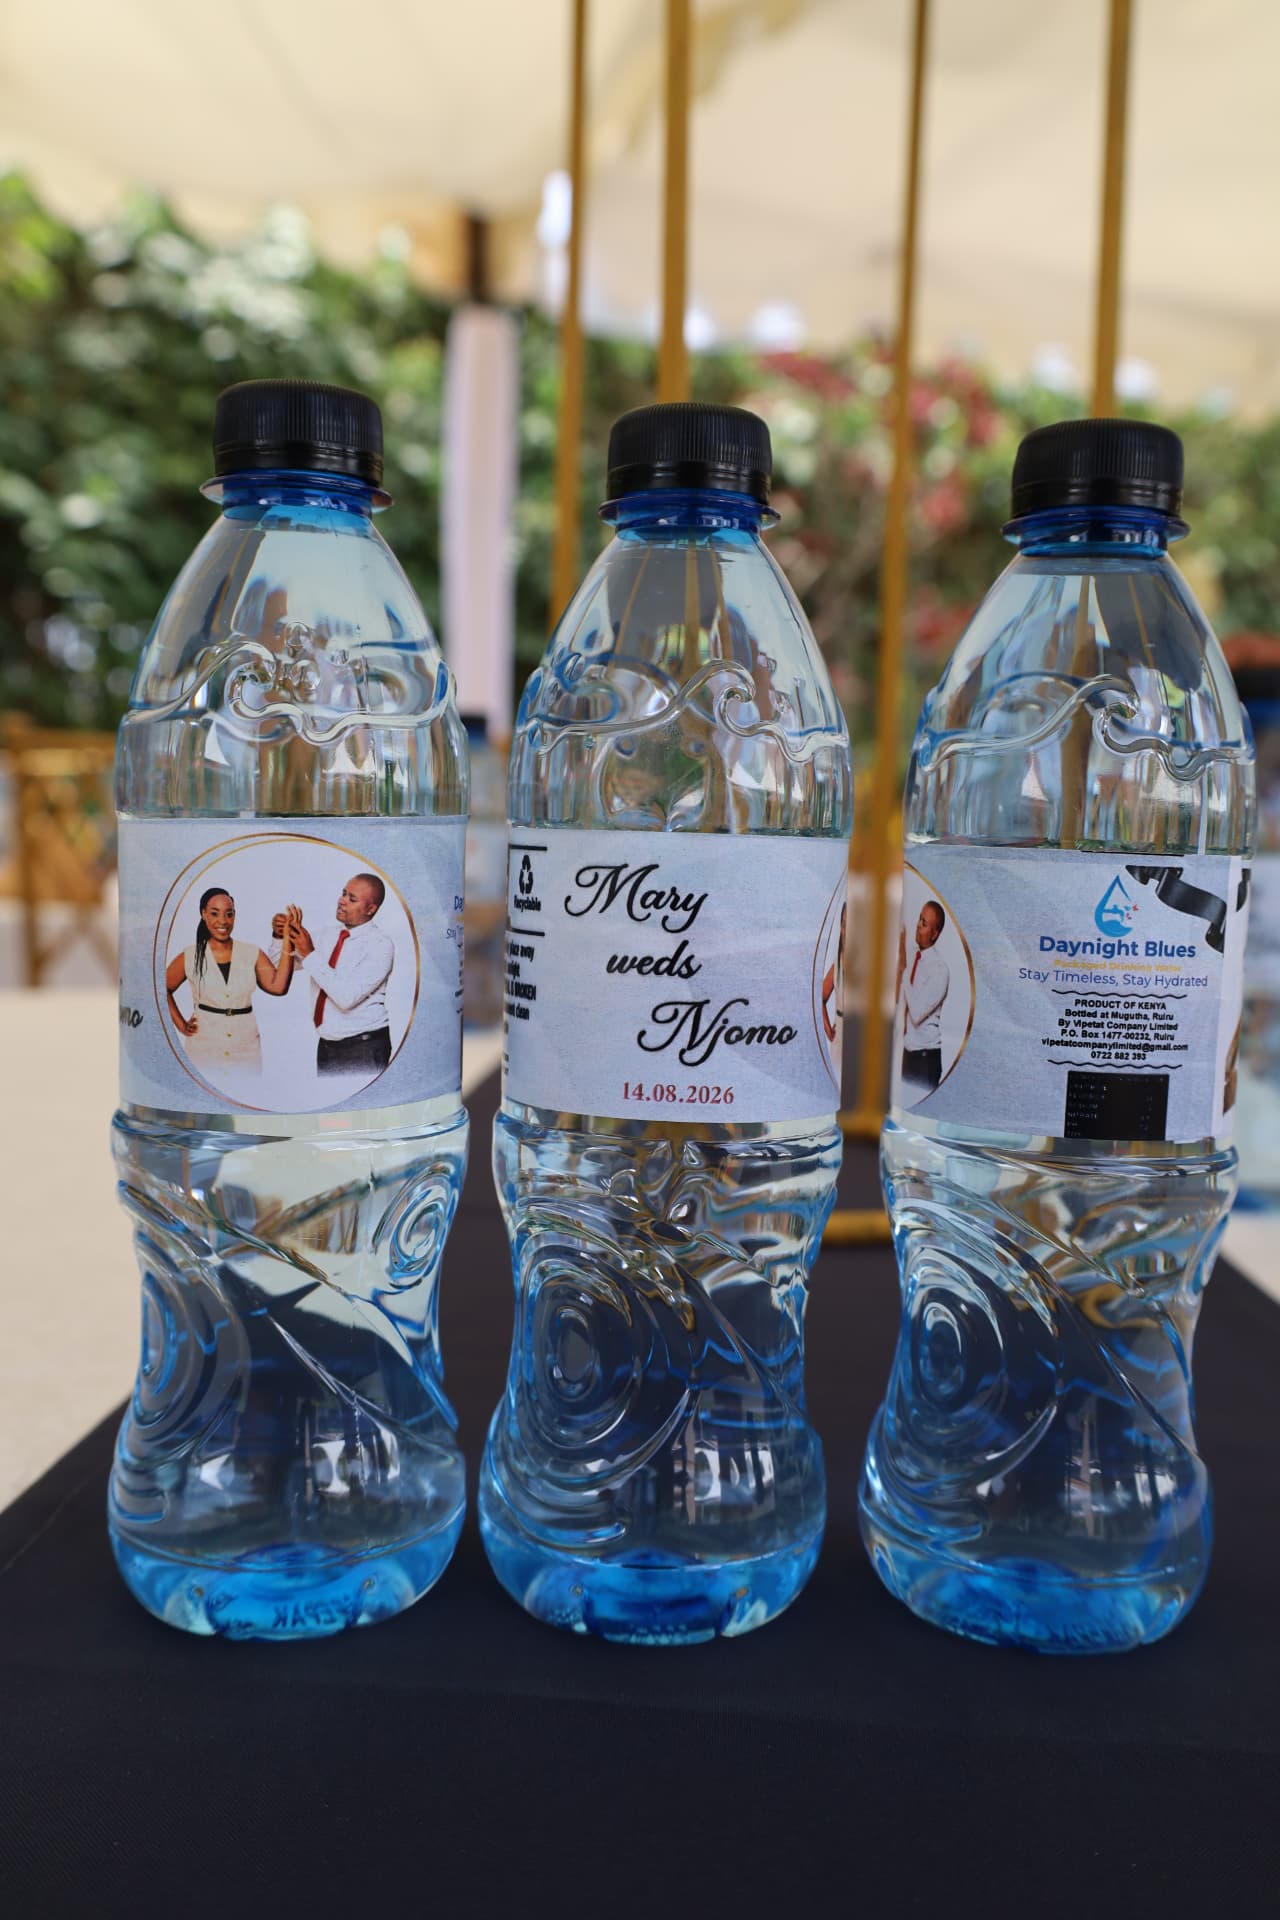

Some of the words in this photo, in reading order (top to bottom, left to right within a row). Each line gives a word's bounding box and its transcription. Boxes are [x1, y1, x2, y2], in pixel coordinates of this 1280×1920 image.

[564, 863, 709, 934] Mary
[1039, 936, 1139, 959] Daynight
[1144, 941, 1196, 958] Blues
[606, 940, 702, 979] weds
[1019, 967, 1049, 983] Stay
[1053, 969, 1119, 987] Timeless,
[1122, 973, 1151, 989] Stay
[1155, 974, 1208, 988] Hydrated
[1064, 1009, 1098, 1019] Bottled
[1100, 1010, 1109, 1019] at
[1111, 1011, 1150, 1022] Mugutha,
[1152, 1012, 1174, 1021] Ruiru
[1074, 999, 1121, 1009] PRODUCT
[1123, 1001, 1136, 1009] OF
[1138, 1001, 1167, 1010] KENYA
[637, 998, 798, 1067] Njomo
[1058, 1019, 1071, 1028] By
[1073, 1019, 1105, 1029] Vipetat
[1106, 1021, 1147, 1032] Company
[1150, 1022, 1178, 1031] Limited
[1060, 1029, 1078, 1038] P.O.
[1081, 1030, 1099, 1039] Box
[1153, 1032, 1175, 1041] Ruiru
[1091, 1051, 1112, 1060] 0722
[623, 1082, 735, 1105] 14.08.2026
